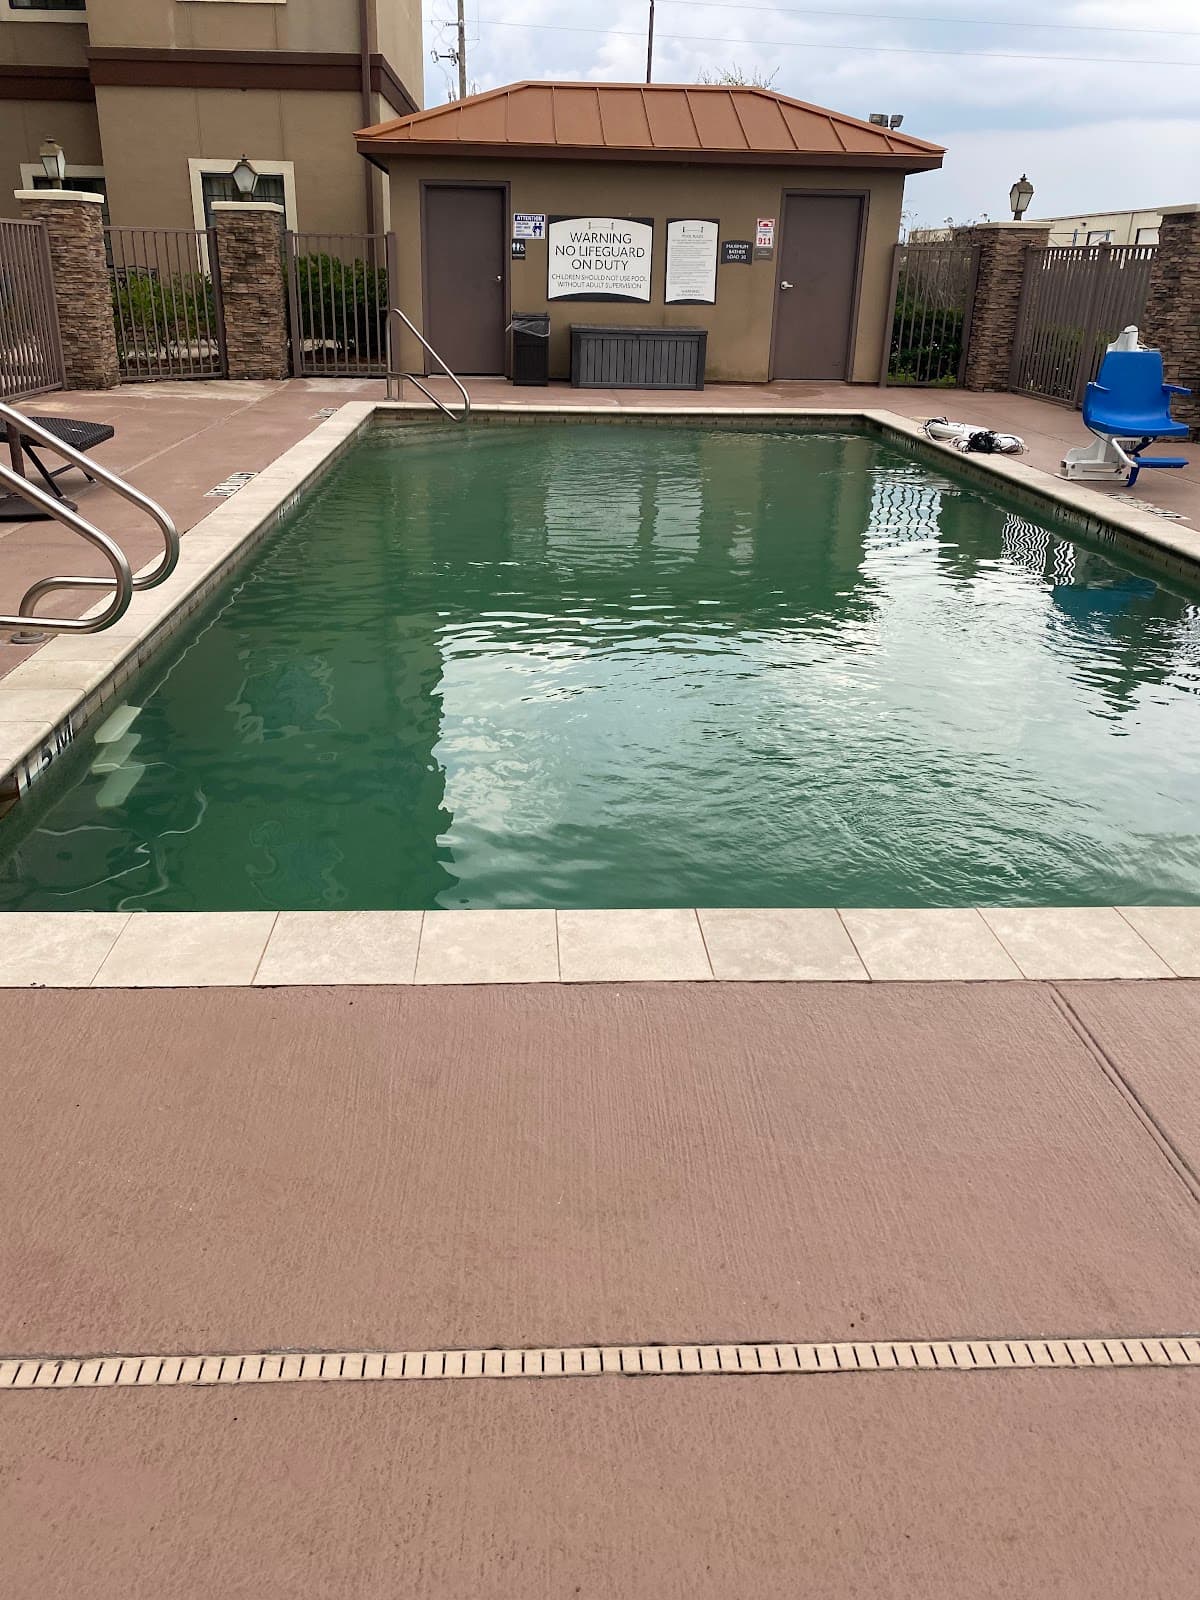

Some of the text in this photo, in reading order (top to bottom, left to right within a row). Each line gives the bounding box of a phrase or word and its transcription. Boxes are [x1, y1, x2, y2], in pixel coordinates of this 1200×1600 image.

[570, 232, 632, 244] WARNING
[758, 237, 771, 246] 911
[555, 245, 645, 258] NO LIFEGUARD
[571, 259, 629, 271] ON DUTY
[551, 273, 580, 281] CHILDREN
